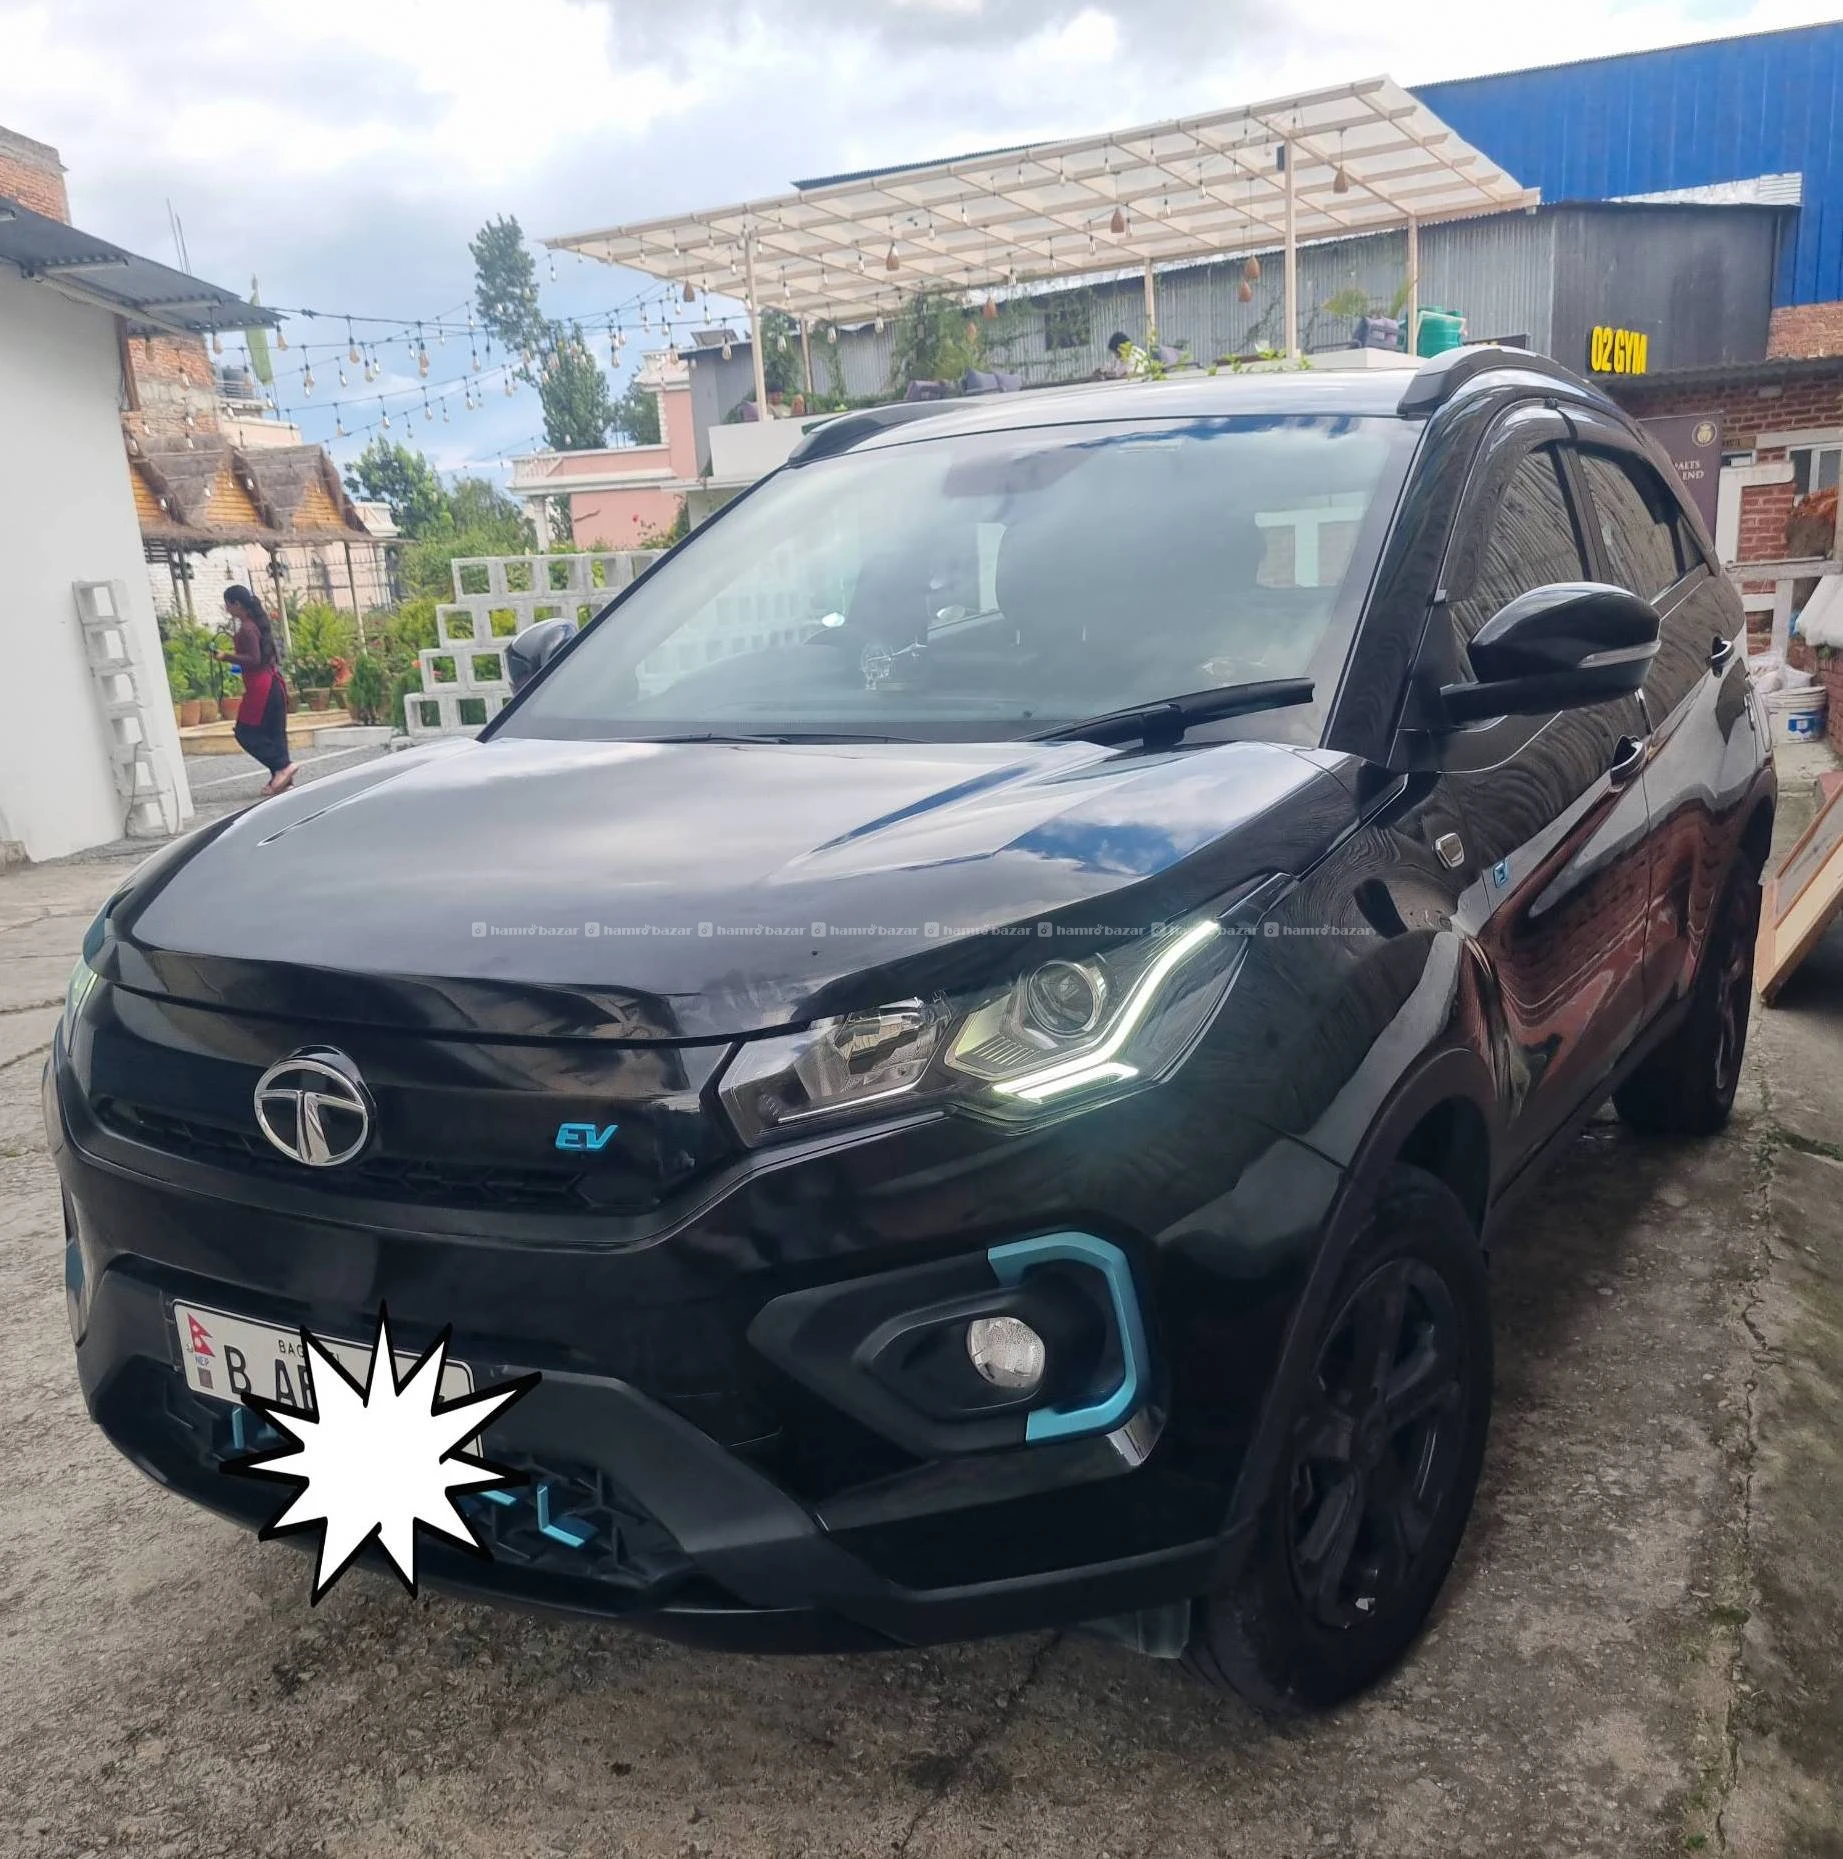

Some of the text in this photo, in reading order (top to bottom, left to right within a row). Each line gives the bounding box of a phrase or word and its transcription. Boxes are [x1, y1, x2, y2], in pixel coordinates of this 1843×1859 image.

[1614, 328, 1648, 375] GYM
[554, 1122, 619, 1150] EV
[224, 1344, 252, 1395] B
